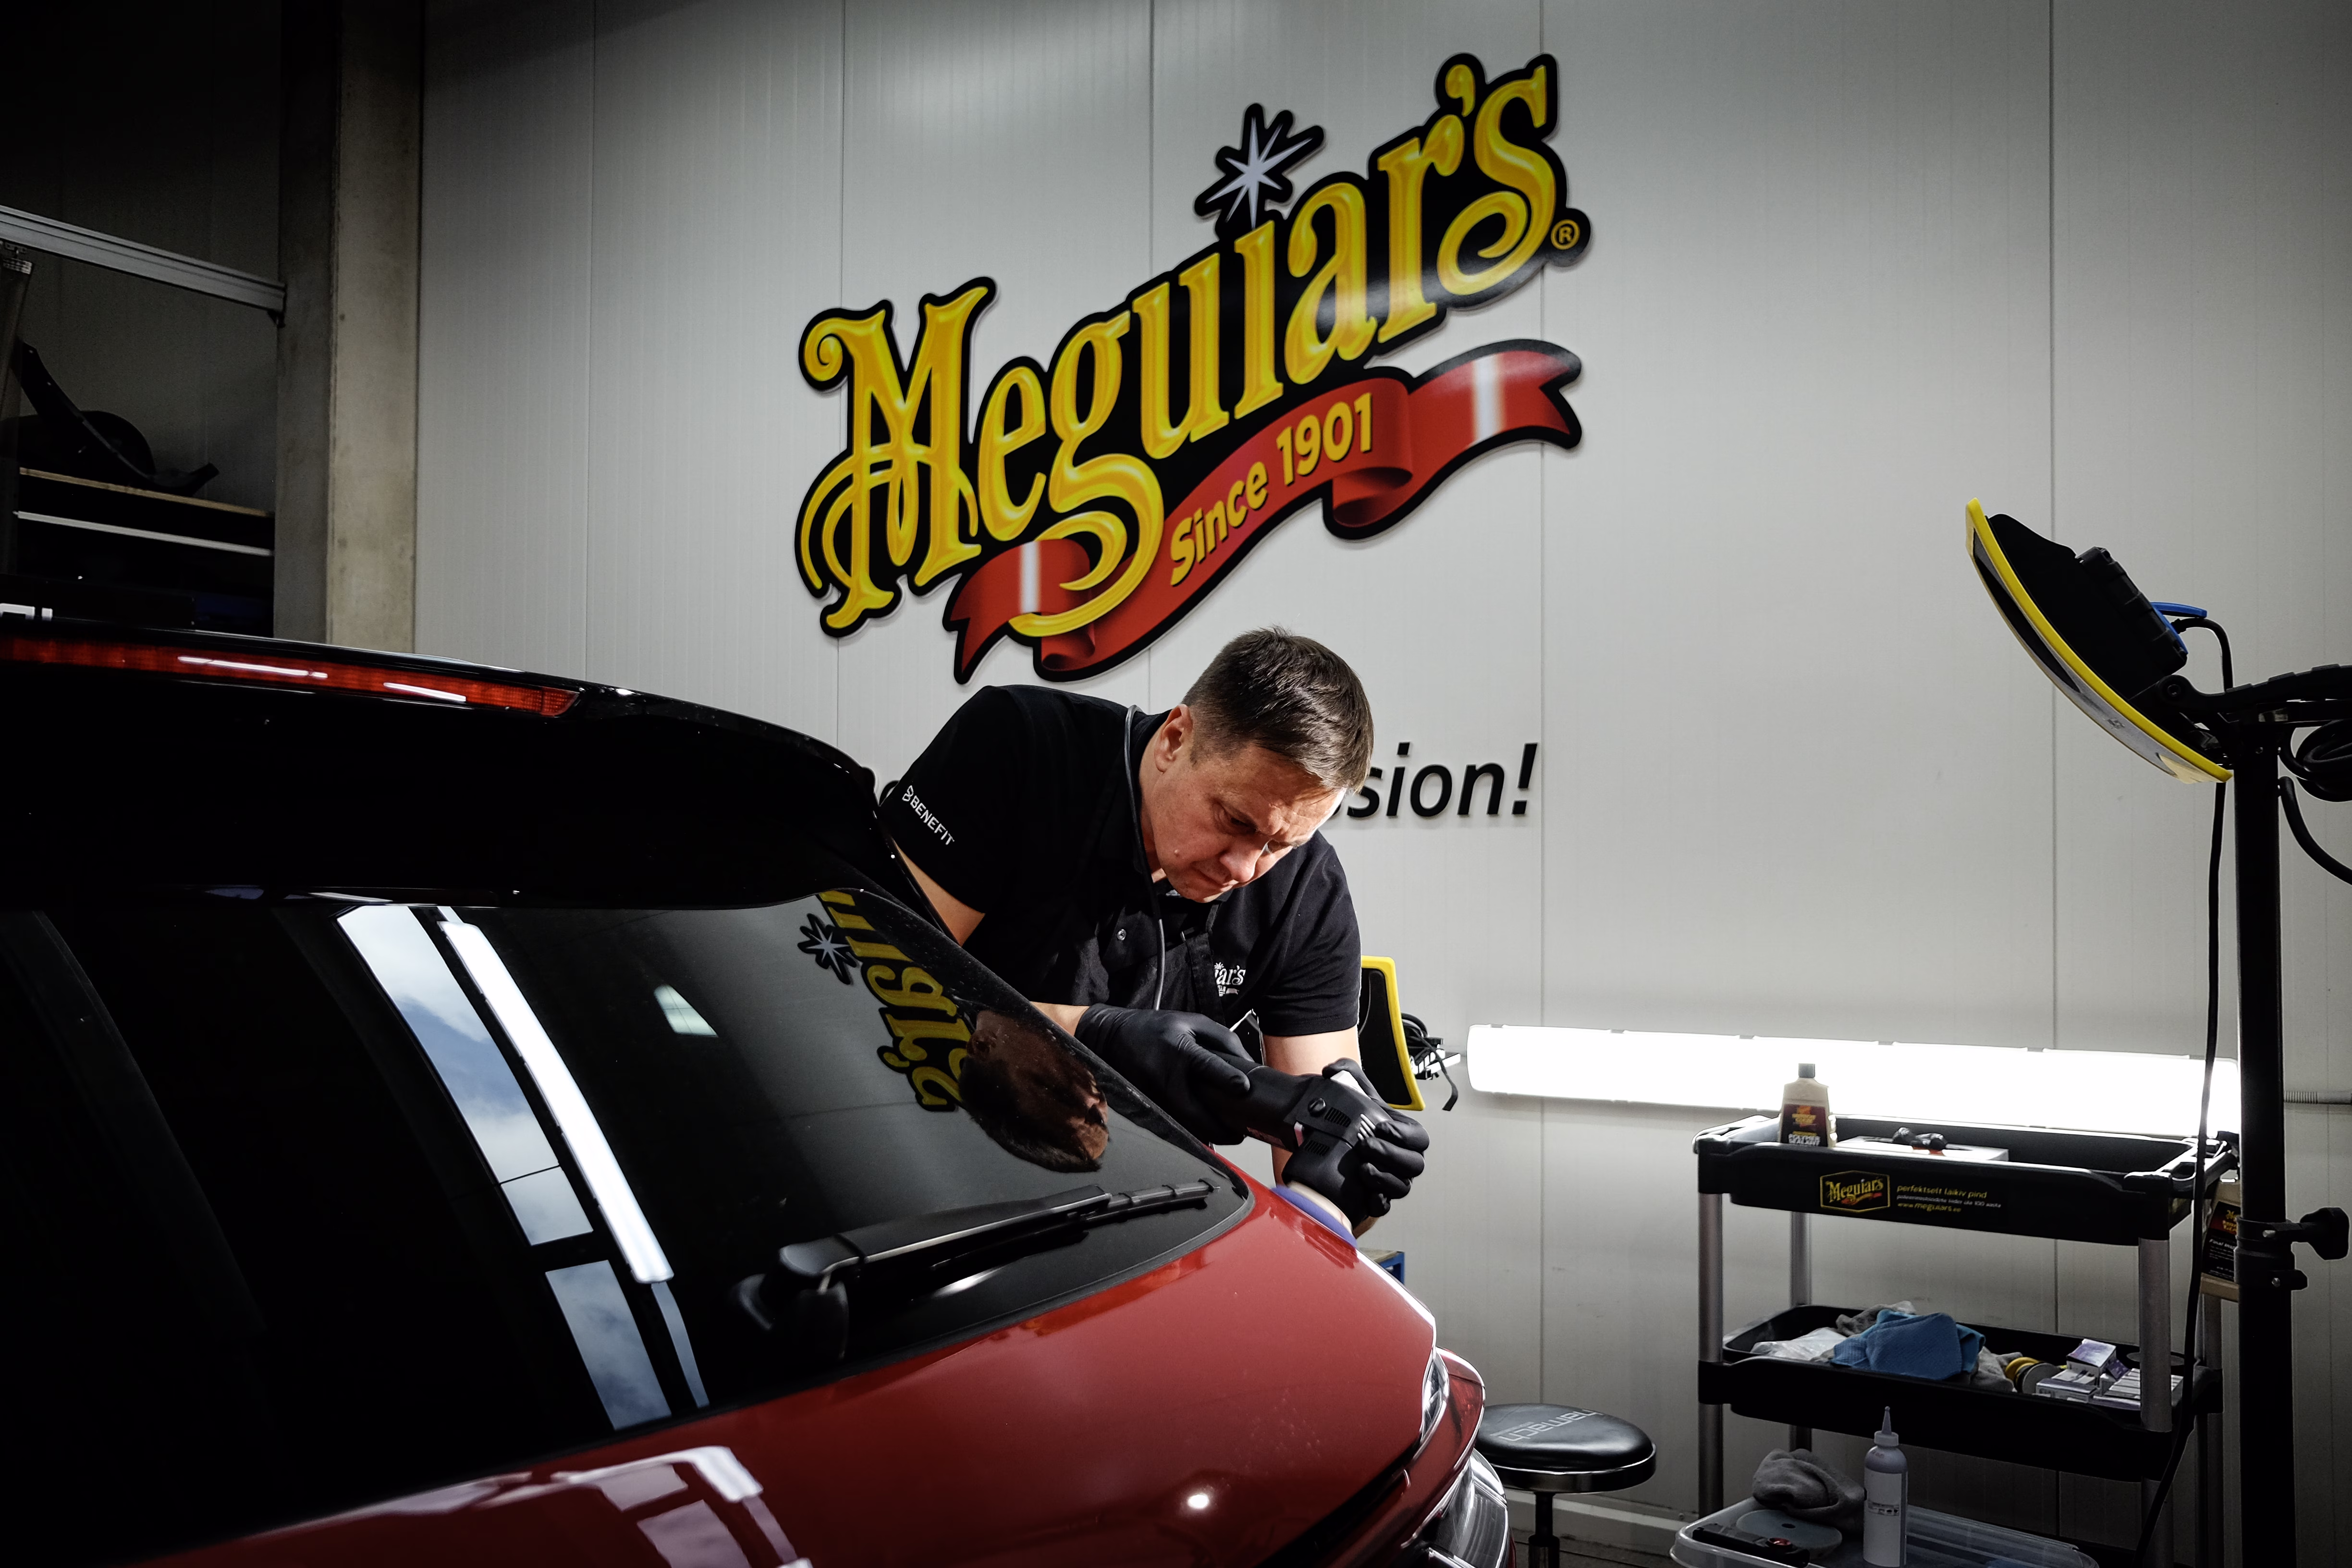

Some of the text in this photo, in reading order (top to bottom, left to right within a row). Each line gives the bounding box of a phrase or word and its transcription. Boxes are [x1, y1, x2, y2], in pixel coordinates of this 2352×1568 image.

[796, 63, 1556, 636] Meguiar's
[1170, 392, 1373, 587] Since 1901
[1332, 741, 1538, 818] sion!
[910, 795, 955, 845] BENEFIT
[1825, 1177, 1884, 1205] Meguiar's
[1968, 1190, 1987, 1200] pind
